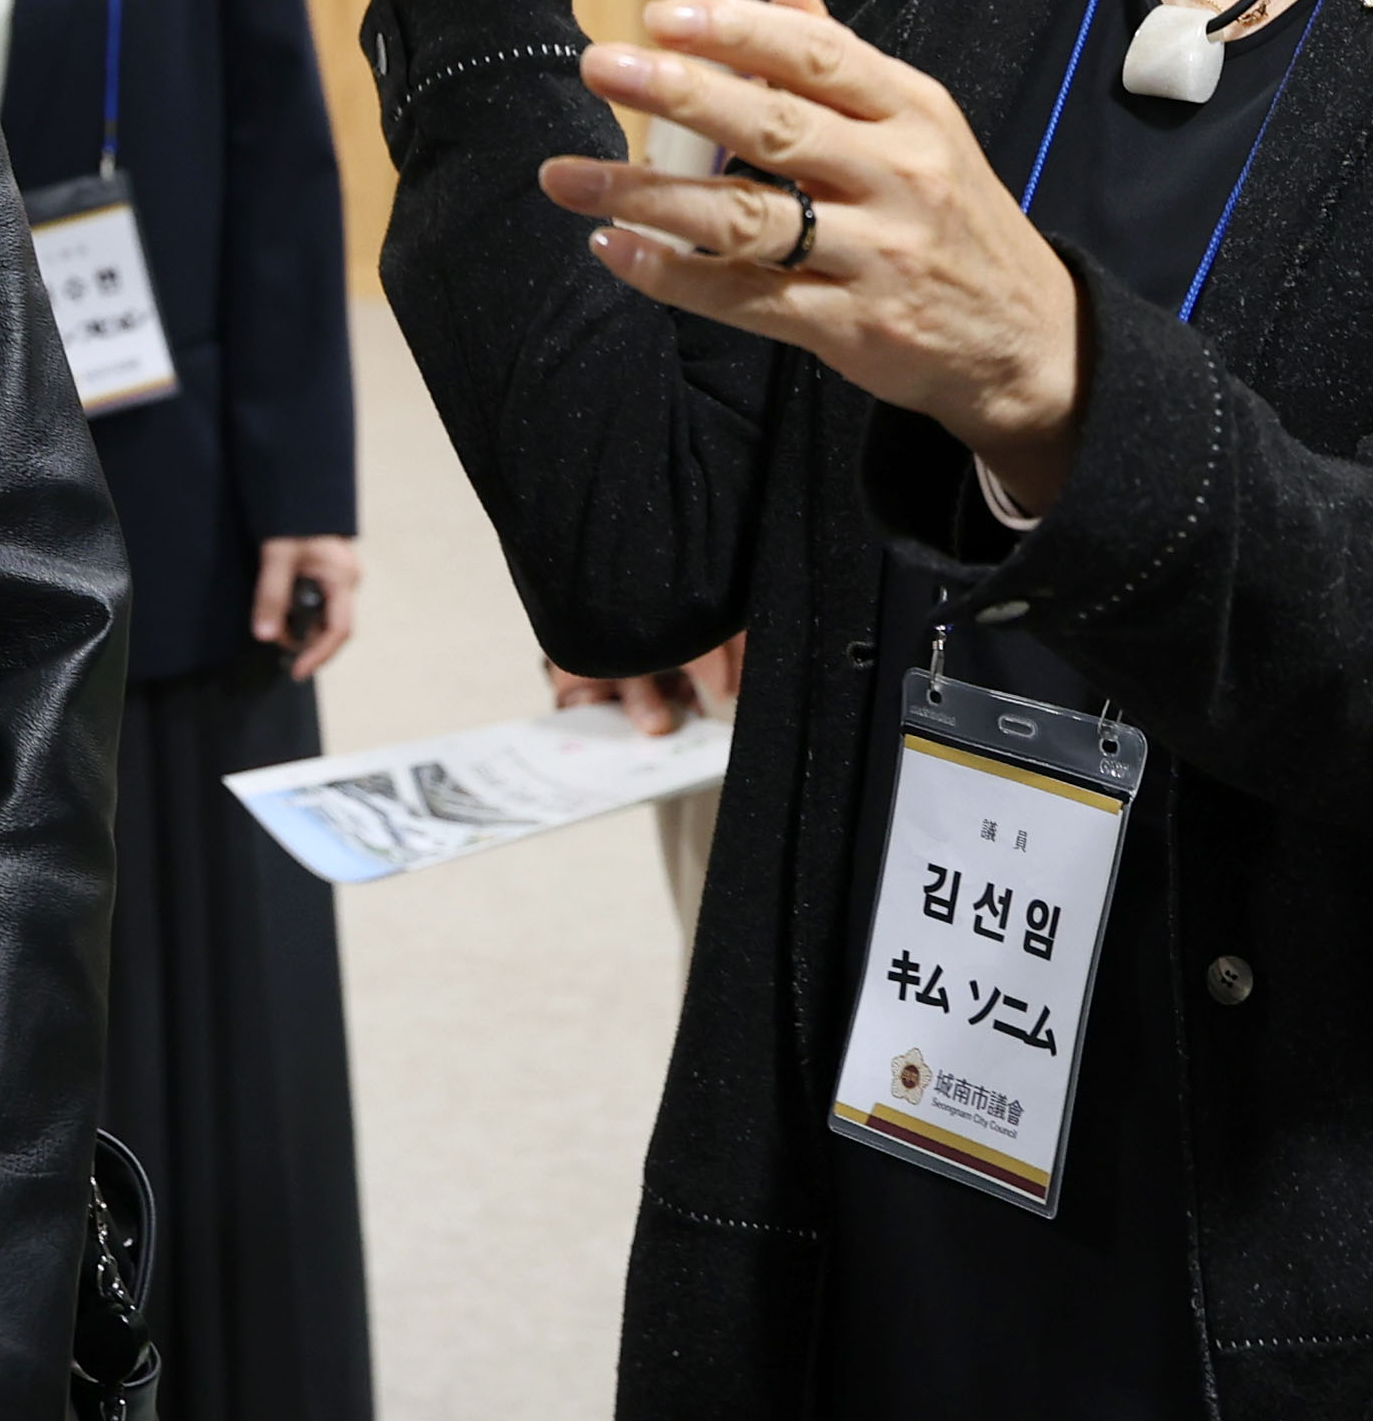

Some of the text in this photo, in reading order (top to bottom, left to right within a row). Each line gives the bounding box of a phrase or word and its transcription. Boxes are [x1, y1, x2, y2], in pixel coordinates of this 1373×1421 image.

[887, 949, 1058, 1057] キム ソニム
[931, 1097, 1018, 1139] Seongnam City Council
[933, 1069, 1025, 1127] 城南市議會
